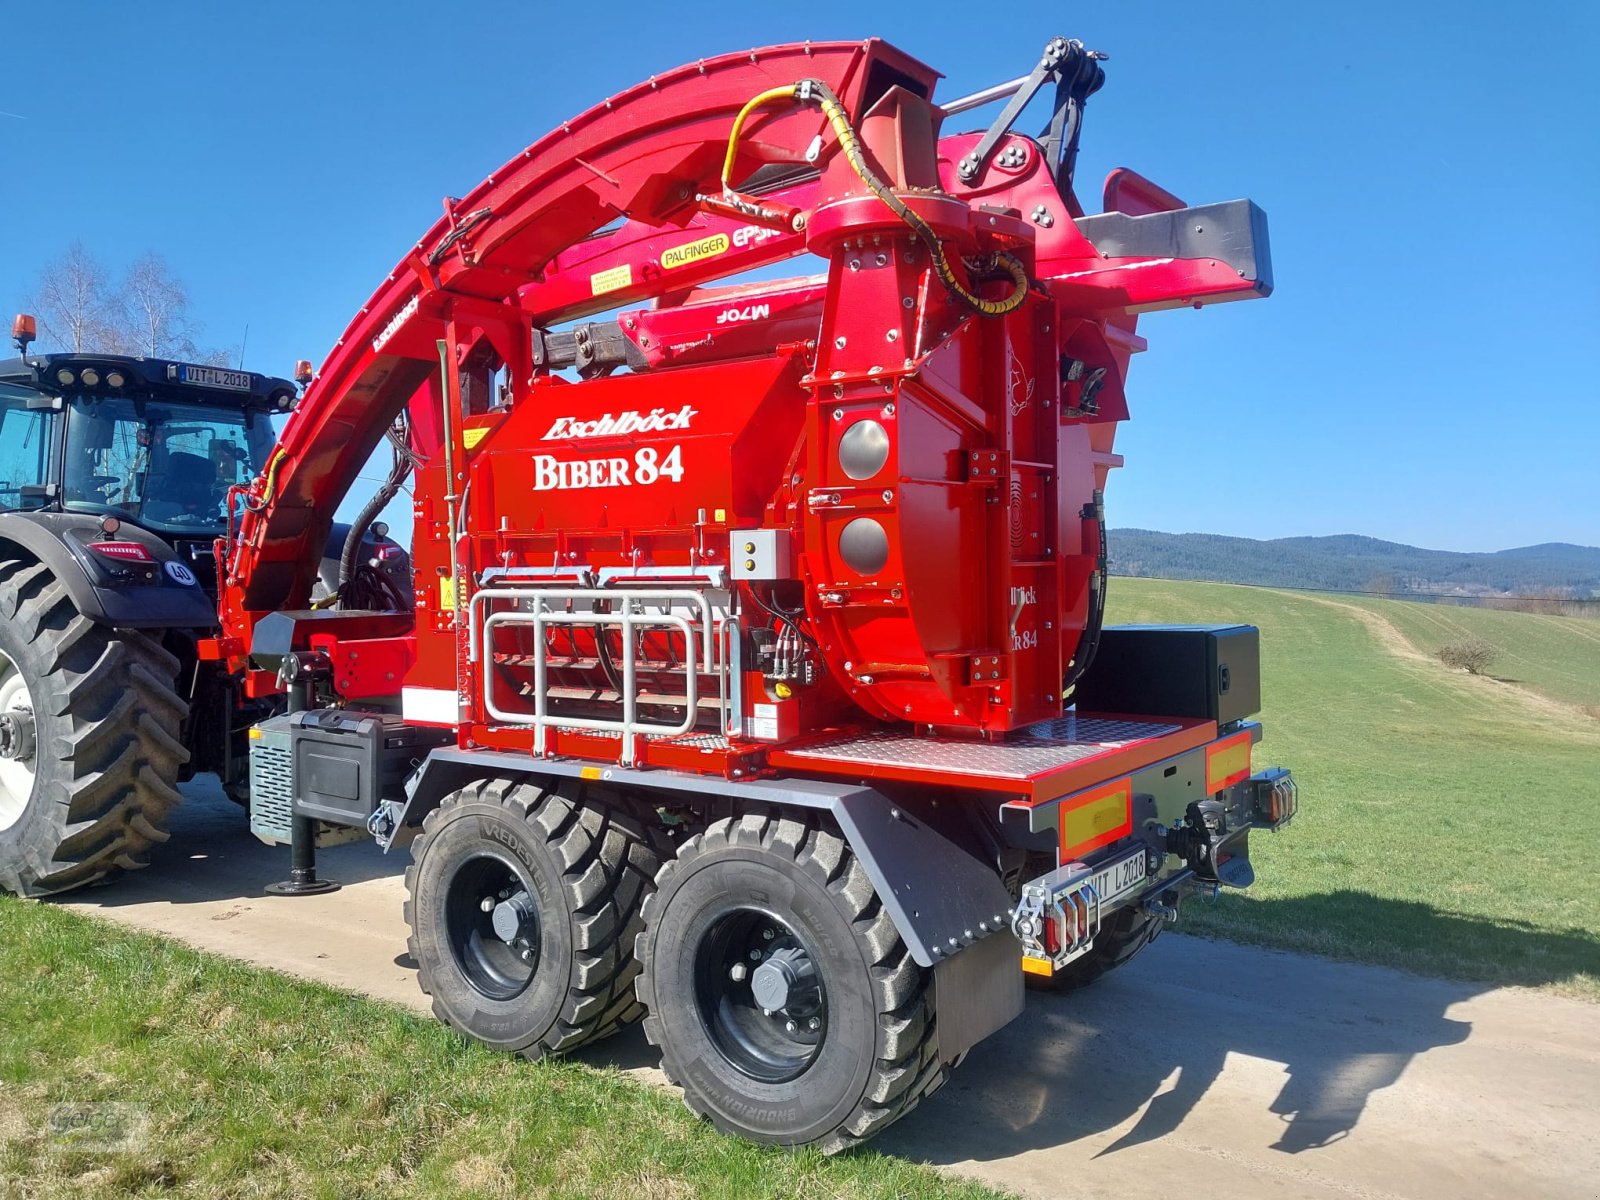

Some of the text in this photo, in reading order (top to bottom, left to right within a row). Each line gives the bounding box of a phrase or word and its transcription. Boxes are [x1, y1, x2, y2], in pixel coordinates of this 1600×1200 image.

[665, 237, 725, 265] PALFINGER
[716, 304, 769, 324] M70F
[187, 367, 249, 388] VIT L 2018
[540, 405, 699, 441] Eschlböck
[532, 445, 685, 491] BIBER 84
[170, 564, 192, 581] 40
[1022, 630, 1038, 649] 84
[1122, 854, 1144, 887] 2018
